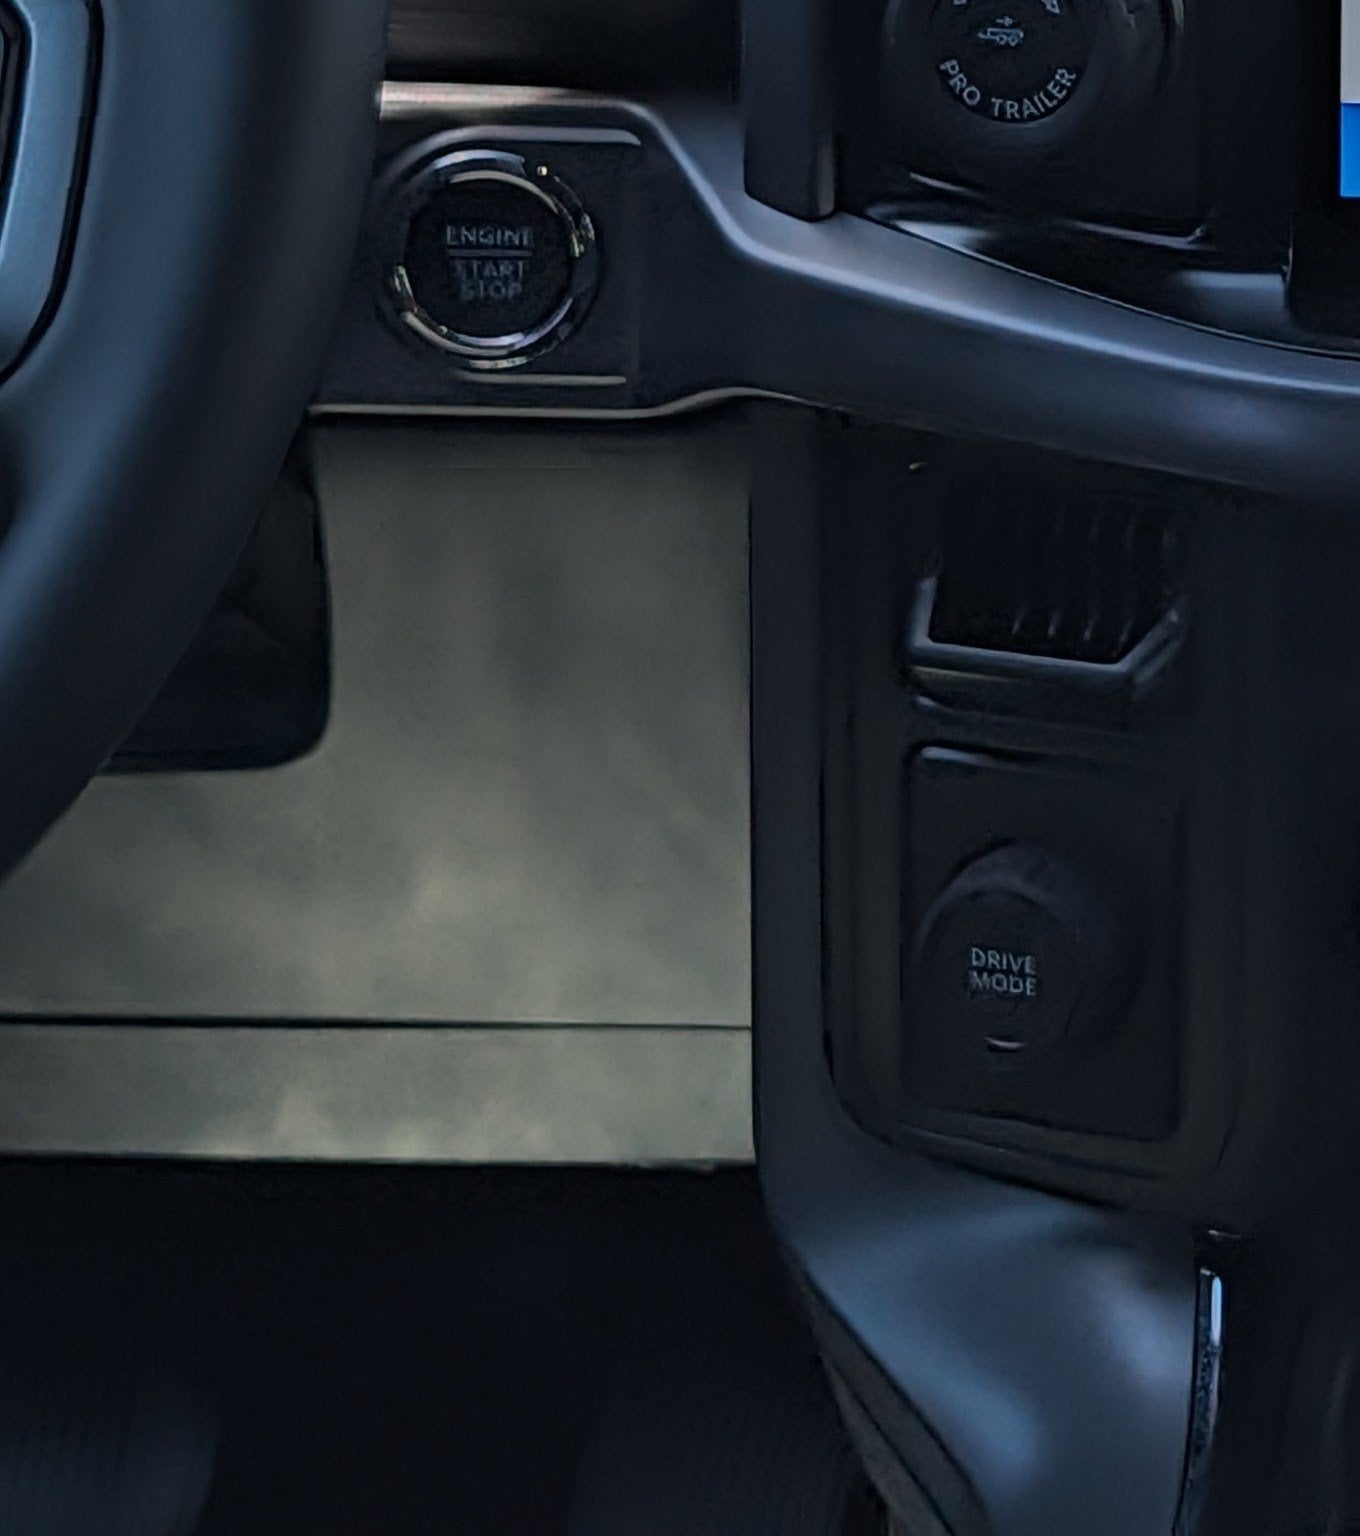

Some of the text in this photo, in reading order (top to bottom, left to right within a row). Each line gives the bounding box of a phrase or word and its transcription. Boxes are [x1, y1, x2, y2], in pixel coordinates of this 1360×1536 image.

[939, 59, 1078, 120] PRO TRAILER
[446, 224, 535, 247] ENGINE
[970, 947, 1037, 975] DRIVE
[969, 970, 1037, 996] MODE
